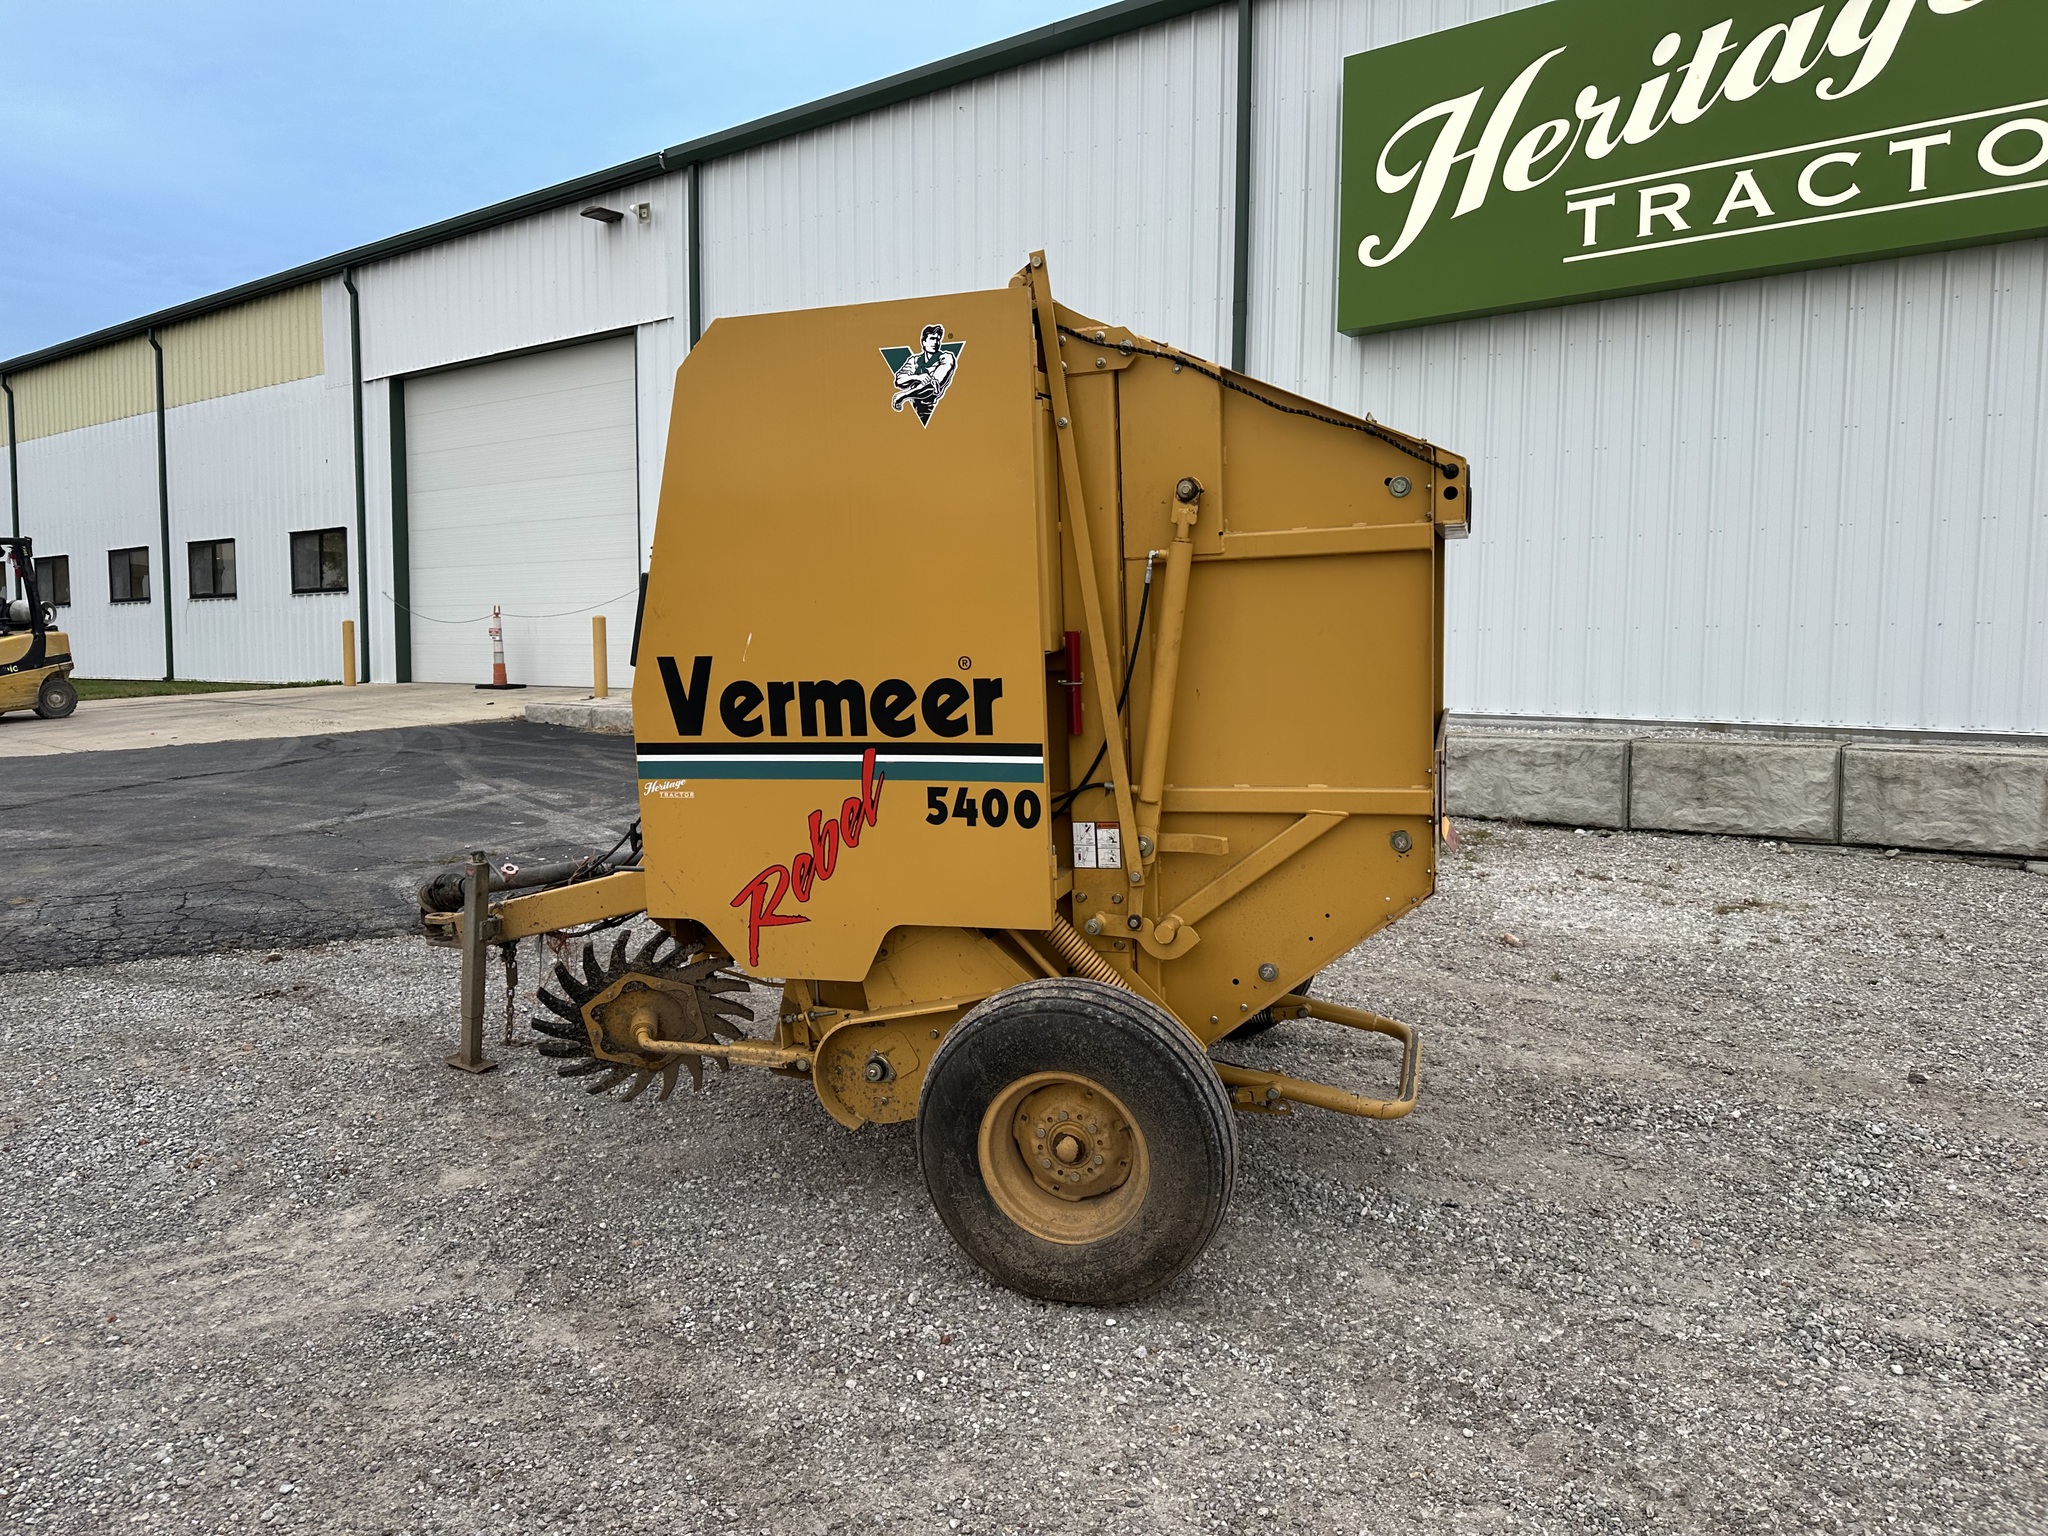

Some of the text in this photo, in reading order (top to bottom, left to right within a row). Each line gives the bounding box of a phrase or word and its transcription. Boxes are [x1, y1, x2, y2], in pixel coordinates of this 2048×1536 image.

[1357, 0, 1984, 268] Heritag
[656, 655, 1003, 738] Vermeer
[643, 779, 686, 796] Heritage
[925, 786, 1042, 829] 5400
[729, 747, 885, 967] Rebel
